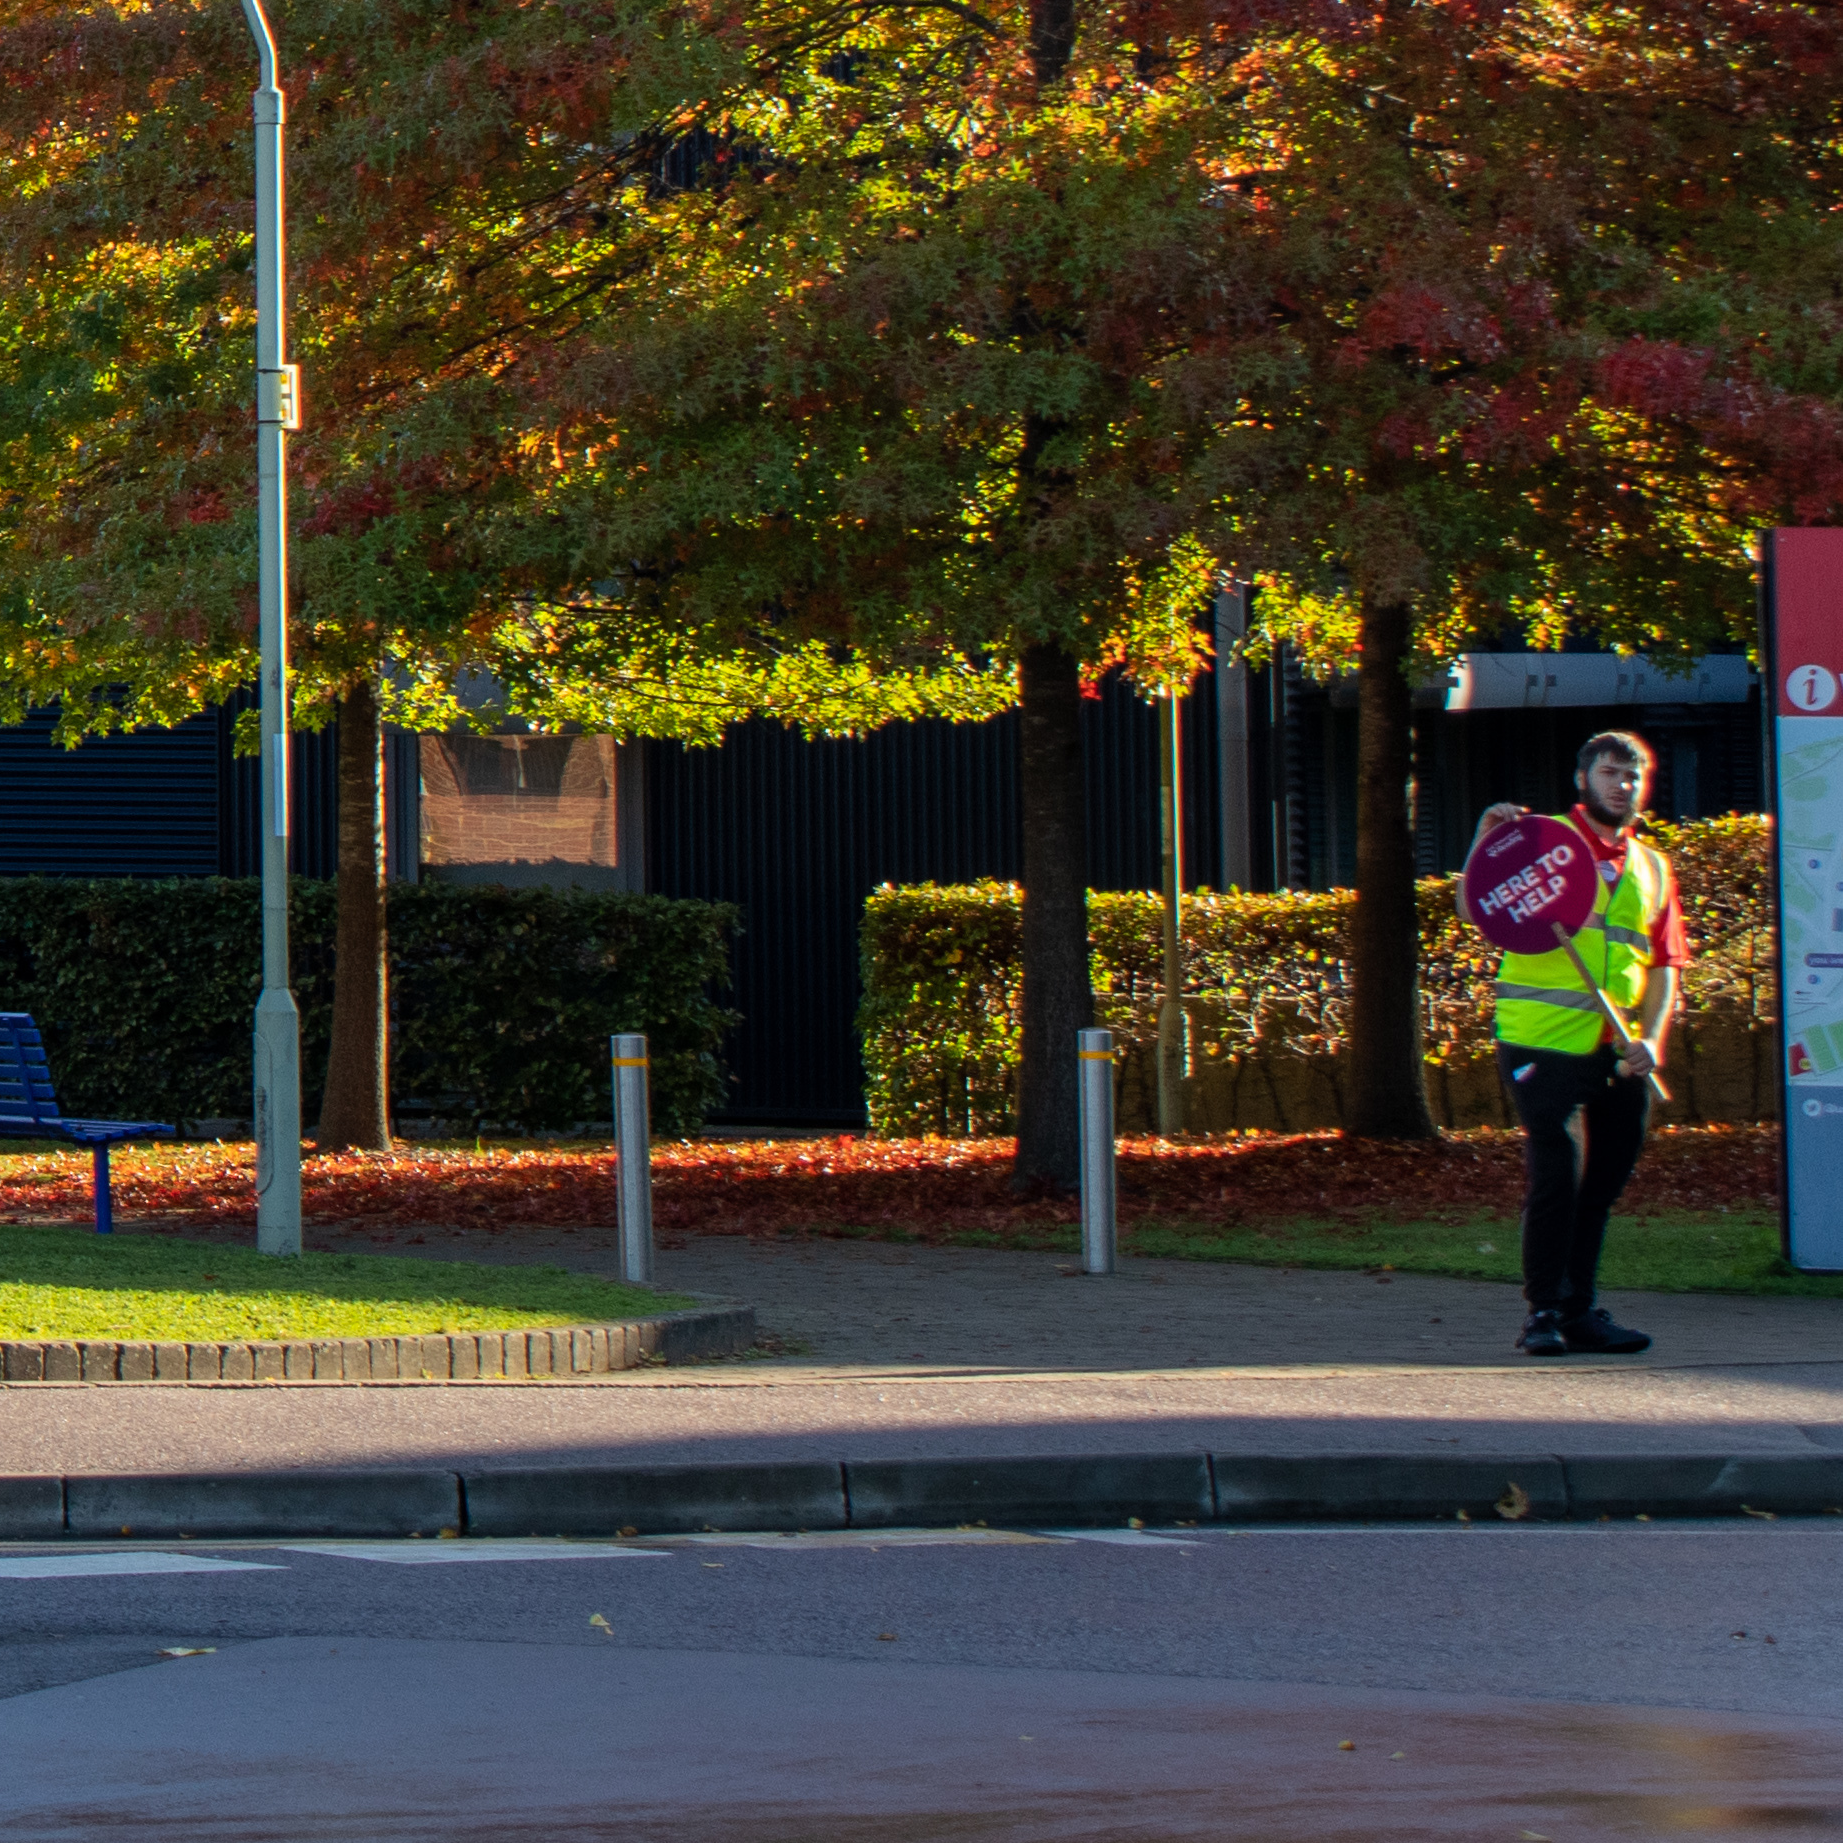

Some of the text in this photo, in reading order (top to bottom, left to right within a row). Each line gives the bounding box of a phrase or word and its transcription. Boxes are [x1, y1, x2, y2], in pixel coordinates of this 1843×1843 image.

[1478, 845, 1574, 915] HERE TO
[1507, 875, 1566, 923] HELP
